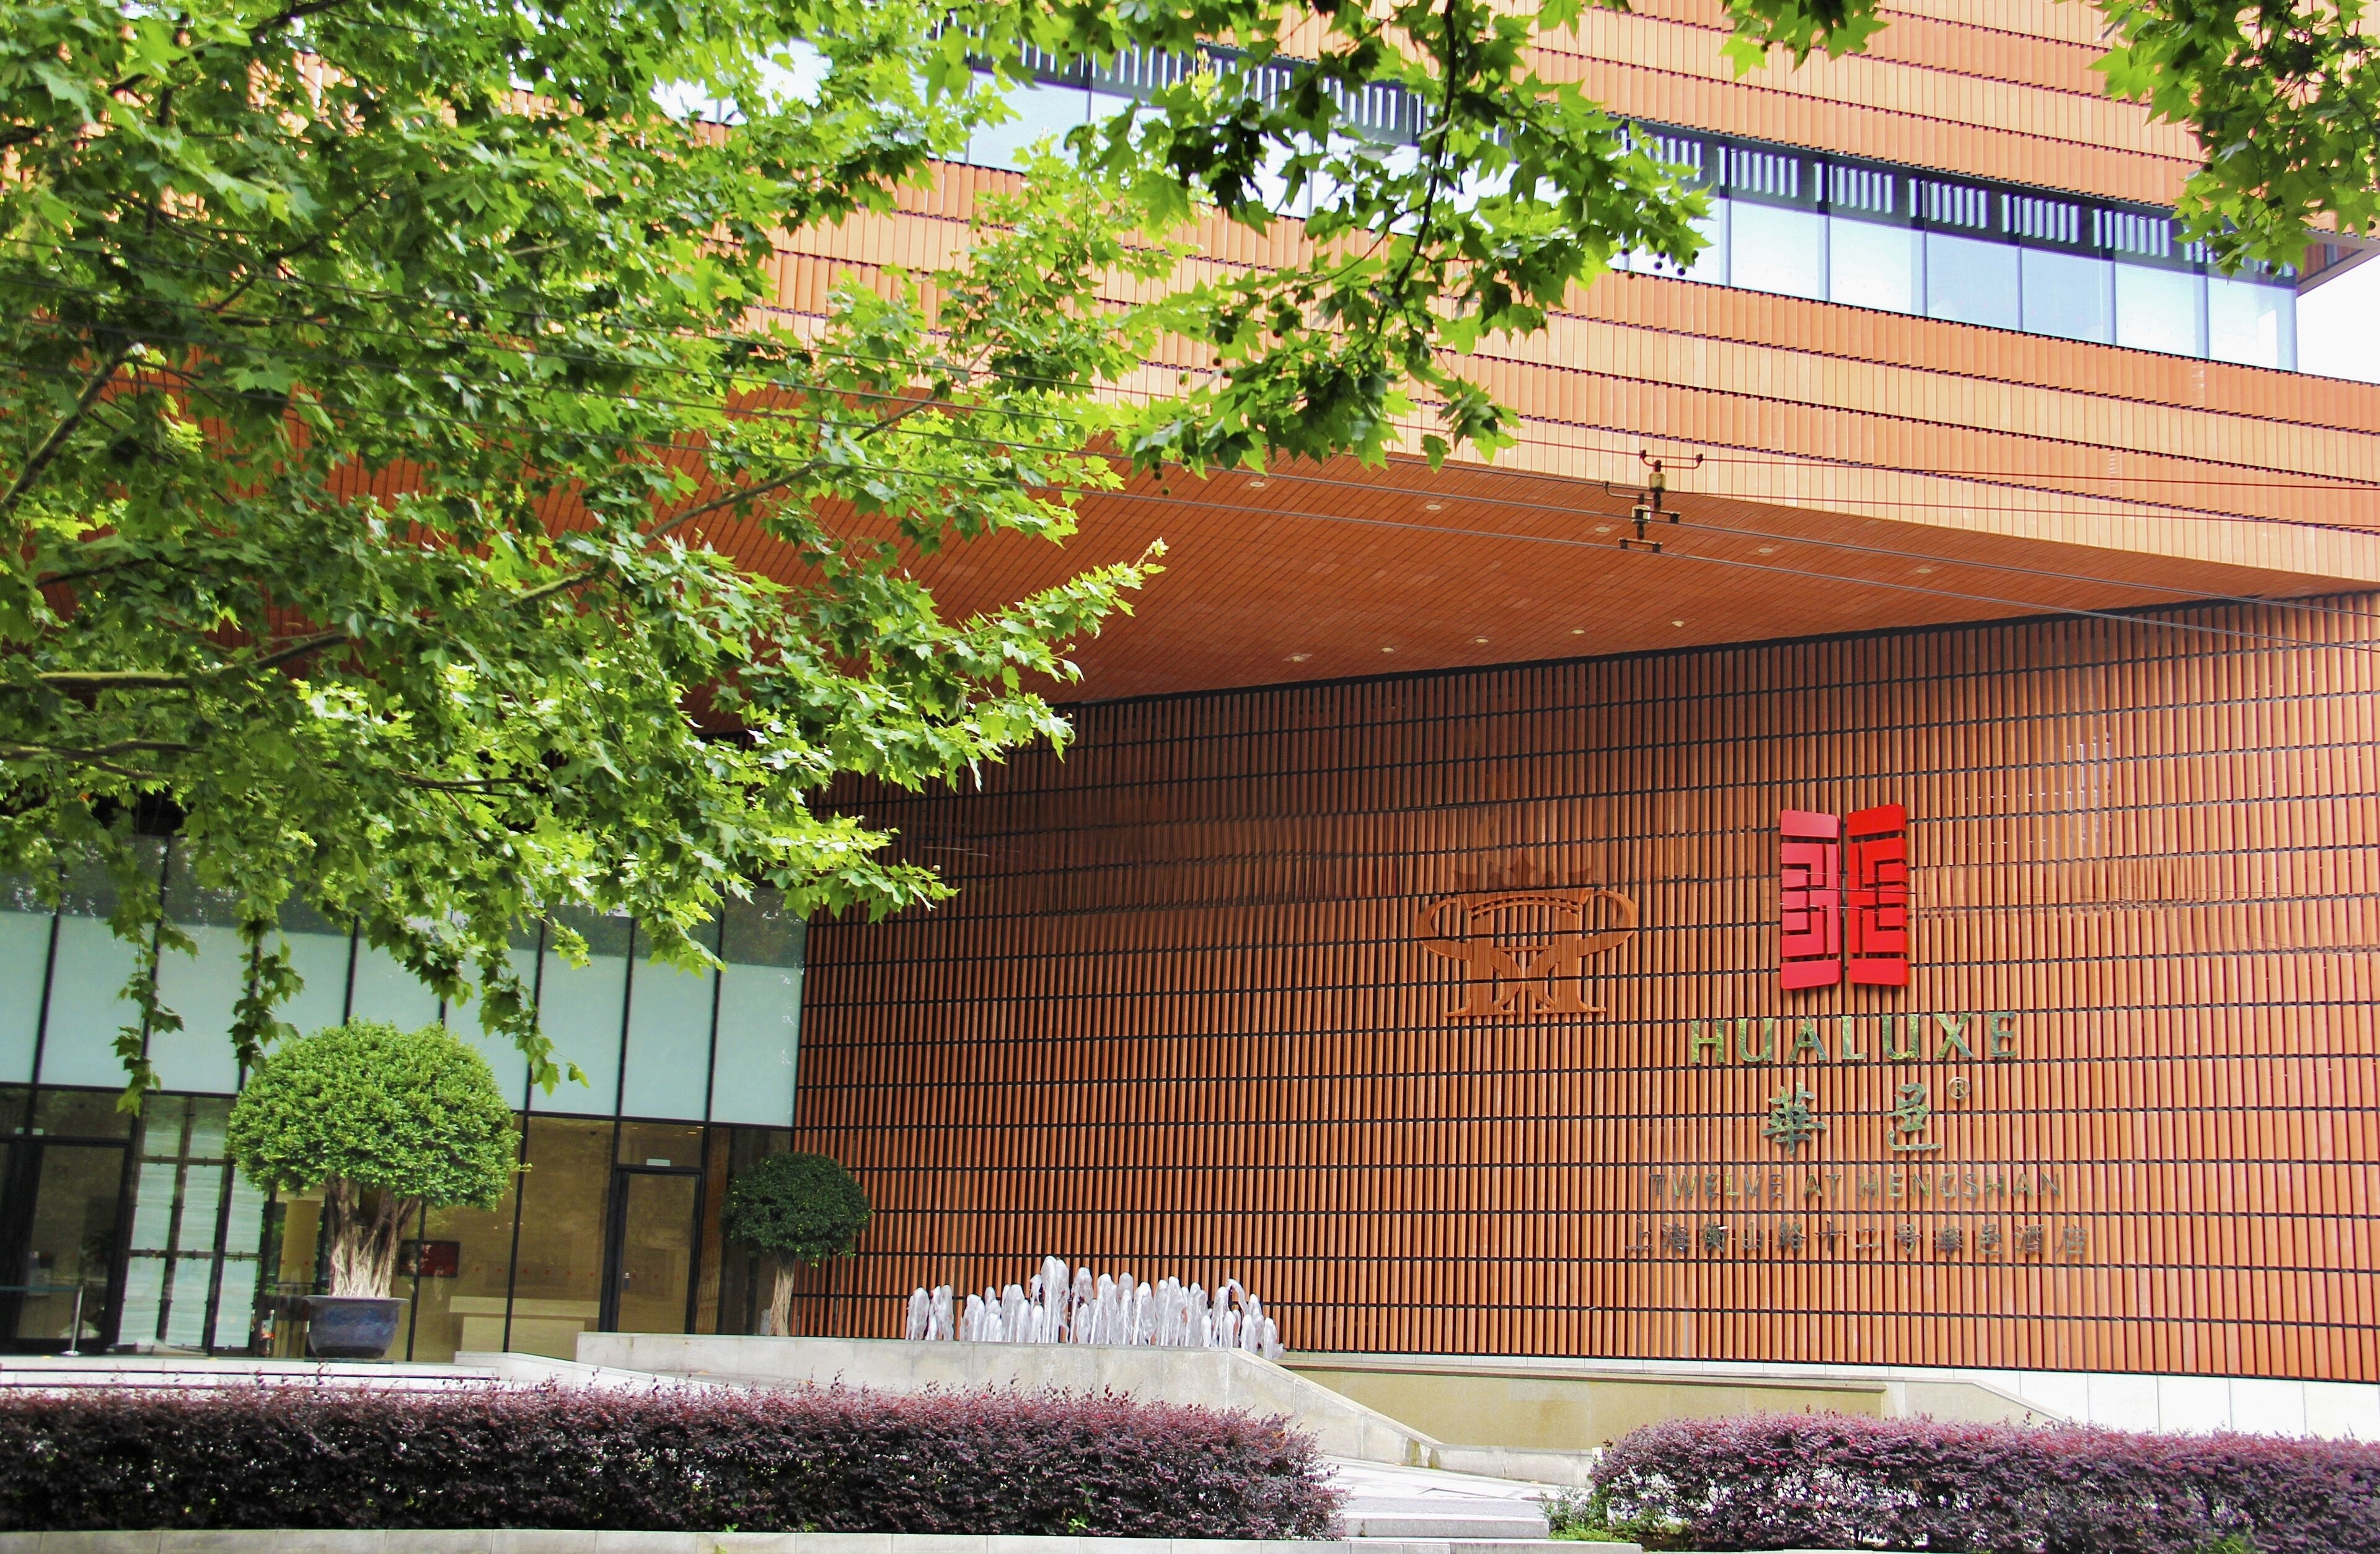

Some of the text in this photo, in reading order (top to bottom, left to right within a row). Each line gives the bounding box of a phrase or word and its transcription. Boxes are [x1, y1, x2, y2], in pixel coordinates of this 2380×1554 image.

[1690, 1011, 2018, 1063] HUALUXE
[1650, 1172, 2061, 1198] TWELVE AT HENGSHAN
